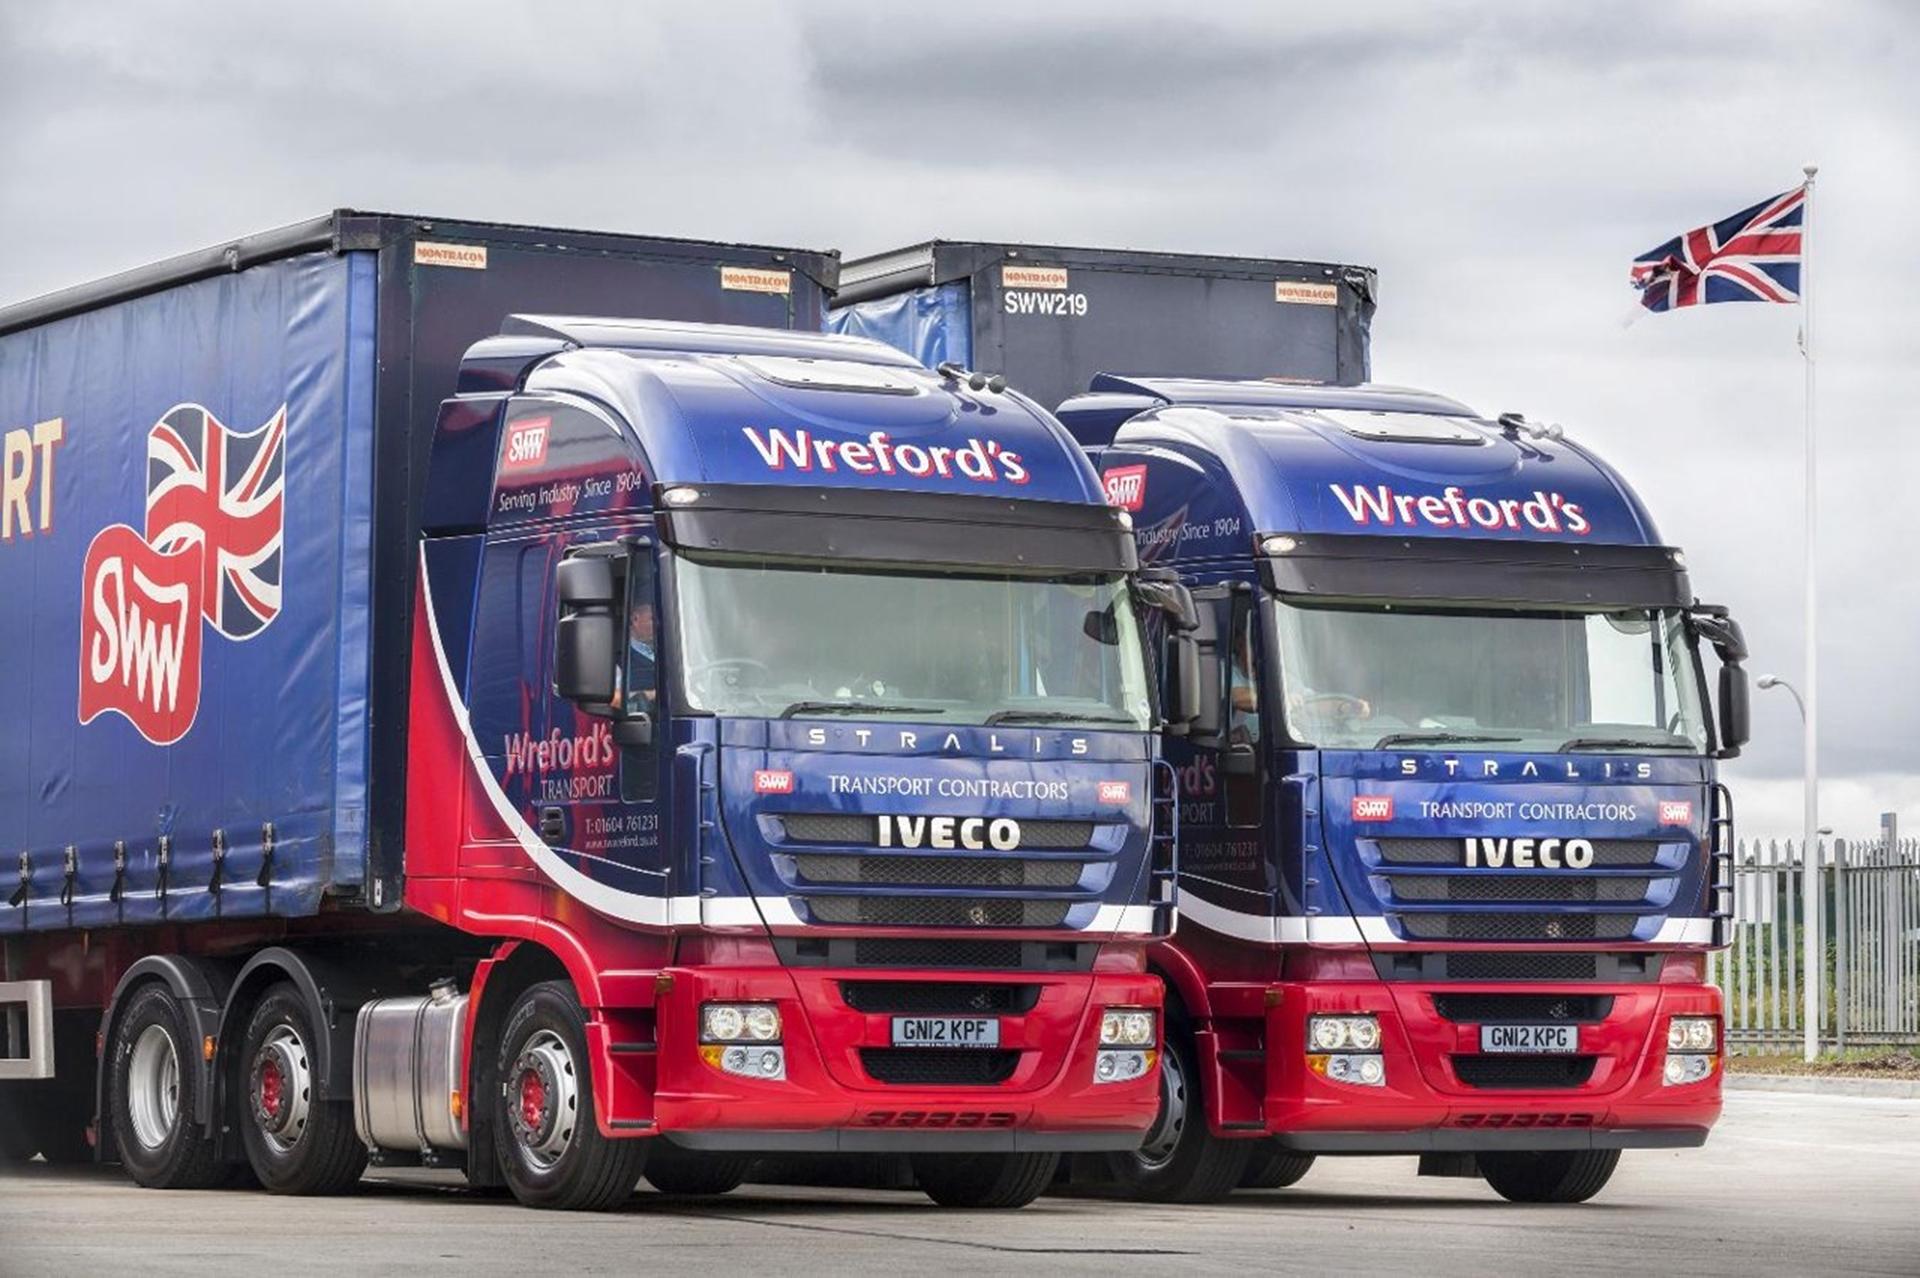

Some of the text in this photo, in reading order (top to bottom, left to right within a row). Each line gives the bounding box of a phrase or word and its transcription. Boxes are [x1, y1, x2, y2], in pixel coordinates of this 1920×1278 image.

[417, 247, 485, 262] MONTRACON
[1005, 272, 1066, 283] MONTRACON
[1004, 290, 1087, 316] SWW219
[742, 427, 1030, 485] Wreford's
[498, 471, 641, 512] Serving Industry Since 1904
[1329, 483, 1591, 535] Wreford's
[1180, 522, 1210, 541] Since
[1214, 518, 1240, 537] 1904
[91, 555, 189, 714] SWW
[504, 723, 614, 773] Wreford's
[809, 728, 1088, 754] STRALIS
[1402, 759, 1651, 778] STRALIS
[540, 775, 614, 800] TRANSPORT
[828, 775, 1069, 800] TRANSPORT CONTRACTORS
[1420, 801, 1636, 821] TRANSPORT CONTRACTORS
[878, 815, 1020, 851] IVECO
[1465, 838, 1594, 869] IVECO
[904, 1020, 987, 1040] GN12 KPF
[1491, 1027, 1567, 1046] GN12 KPG
